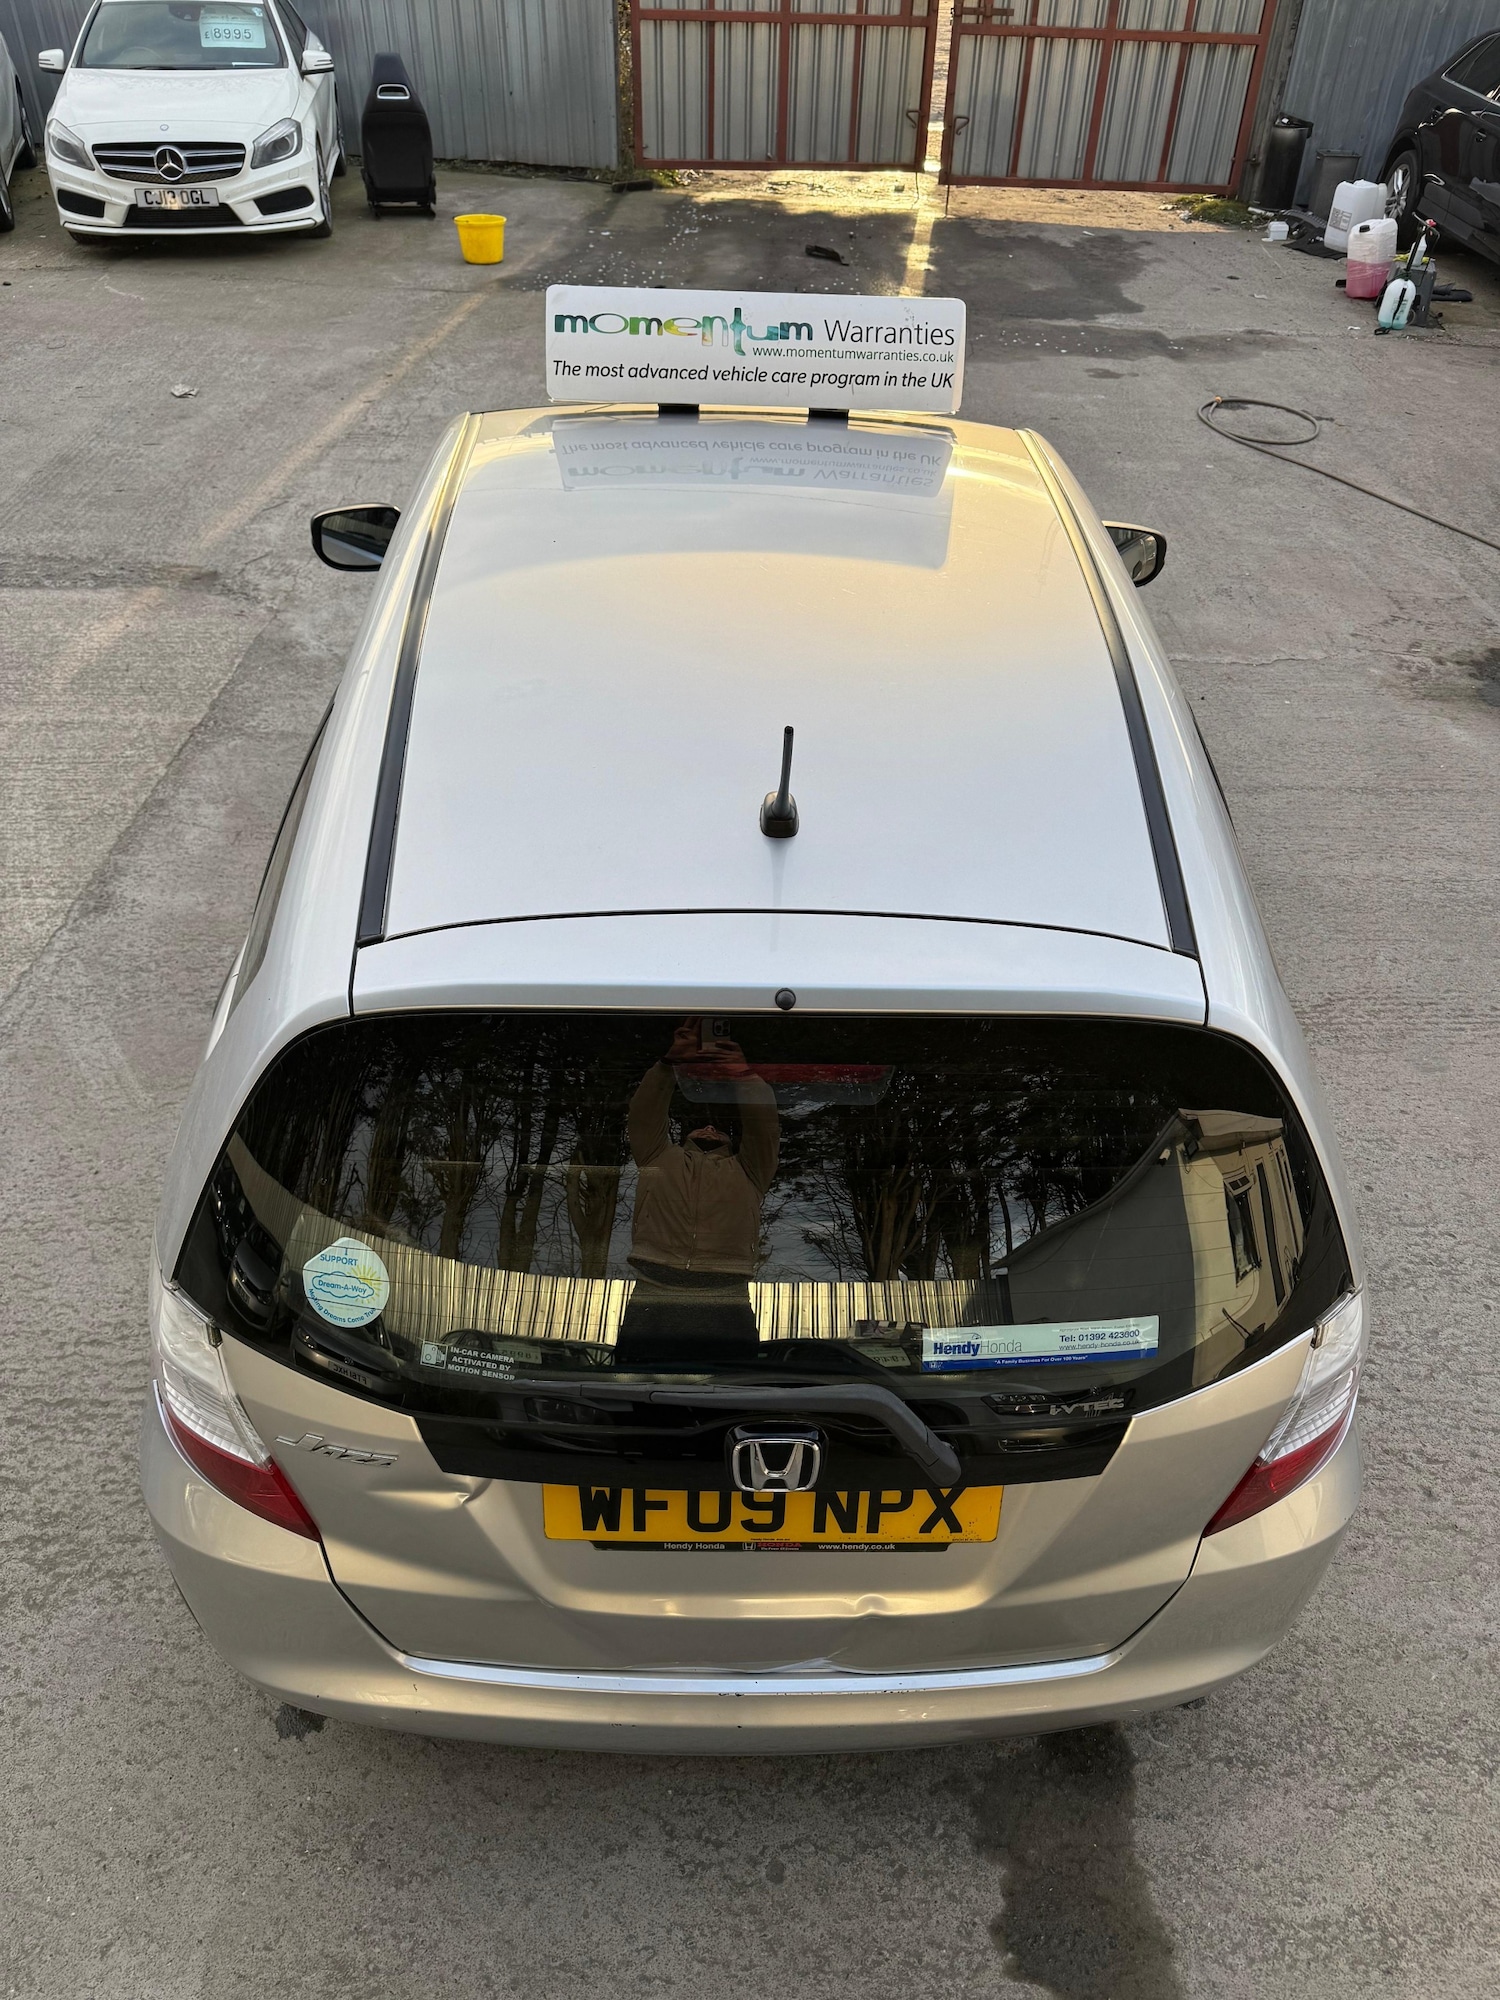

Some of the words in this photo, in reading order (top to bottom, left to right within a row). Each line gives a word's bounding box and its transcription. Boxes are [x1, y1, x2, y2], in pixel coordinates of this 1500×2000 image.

[144, 190, 176, 205] CJ13
[180, 190, 210, 205] OGL
[554, 307, 814, 356] momentum
[824, 319, 955, 346] Warranties
[752, 347, 954, 363] www.momentumwarranties.co.uk
[553, 360, 582, 376] The
[585, 363, 624, 378] most
[627, 363, 709, 381] advanced
[712, 366, 767, 383] vehicle
[771, 371, 807, 384] care
[810, 372, 880, 389] program
[883, 371, 897, 386] in
[902, 372, 927, 387] the
[931, 372, 955, 388] UK
[320, 1253, 359, 1267] SUPPORT
[318, 1279, 368, 1295] Dream-A-Way
[323, 1308, 346, 1323] Dreams
[347, 1315, 366, 1324] Come
[1060, 1334, 1076, 1343] Tel:
[1078, 1333, 1106, 1342] 01392
[450, 1346, 479, 1358] IN-CAR
[480, 1352, 515, 1364] CAMERA
[447, 1363, 481, 1376] MOTION
[482, 1370, 516, 1381] SENSOR
[452, 1356, 498, 1370] ACTIVATED
[499, 1364, 511, 1372] BY
[578, 1485, 785, 1532] WF09
[812, 1486, 964, 1534] NPX
[664, 1541, 693, 1551] Hendy
[695, 1541, 725, 1550] Honda
[818, 1543, 896, 1551] www.hendy.co.uk
